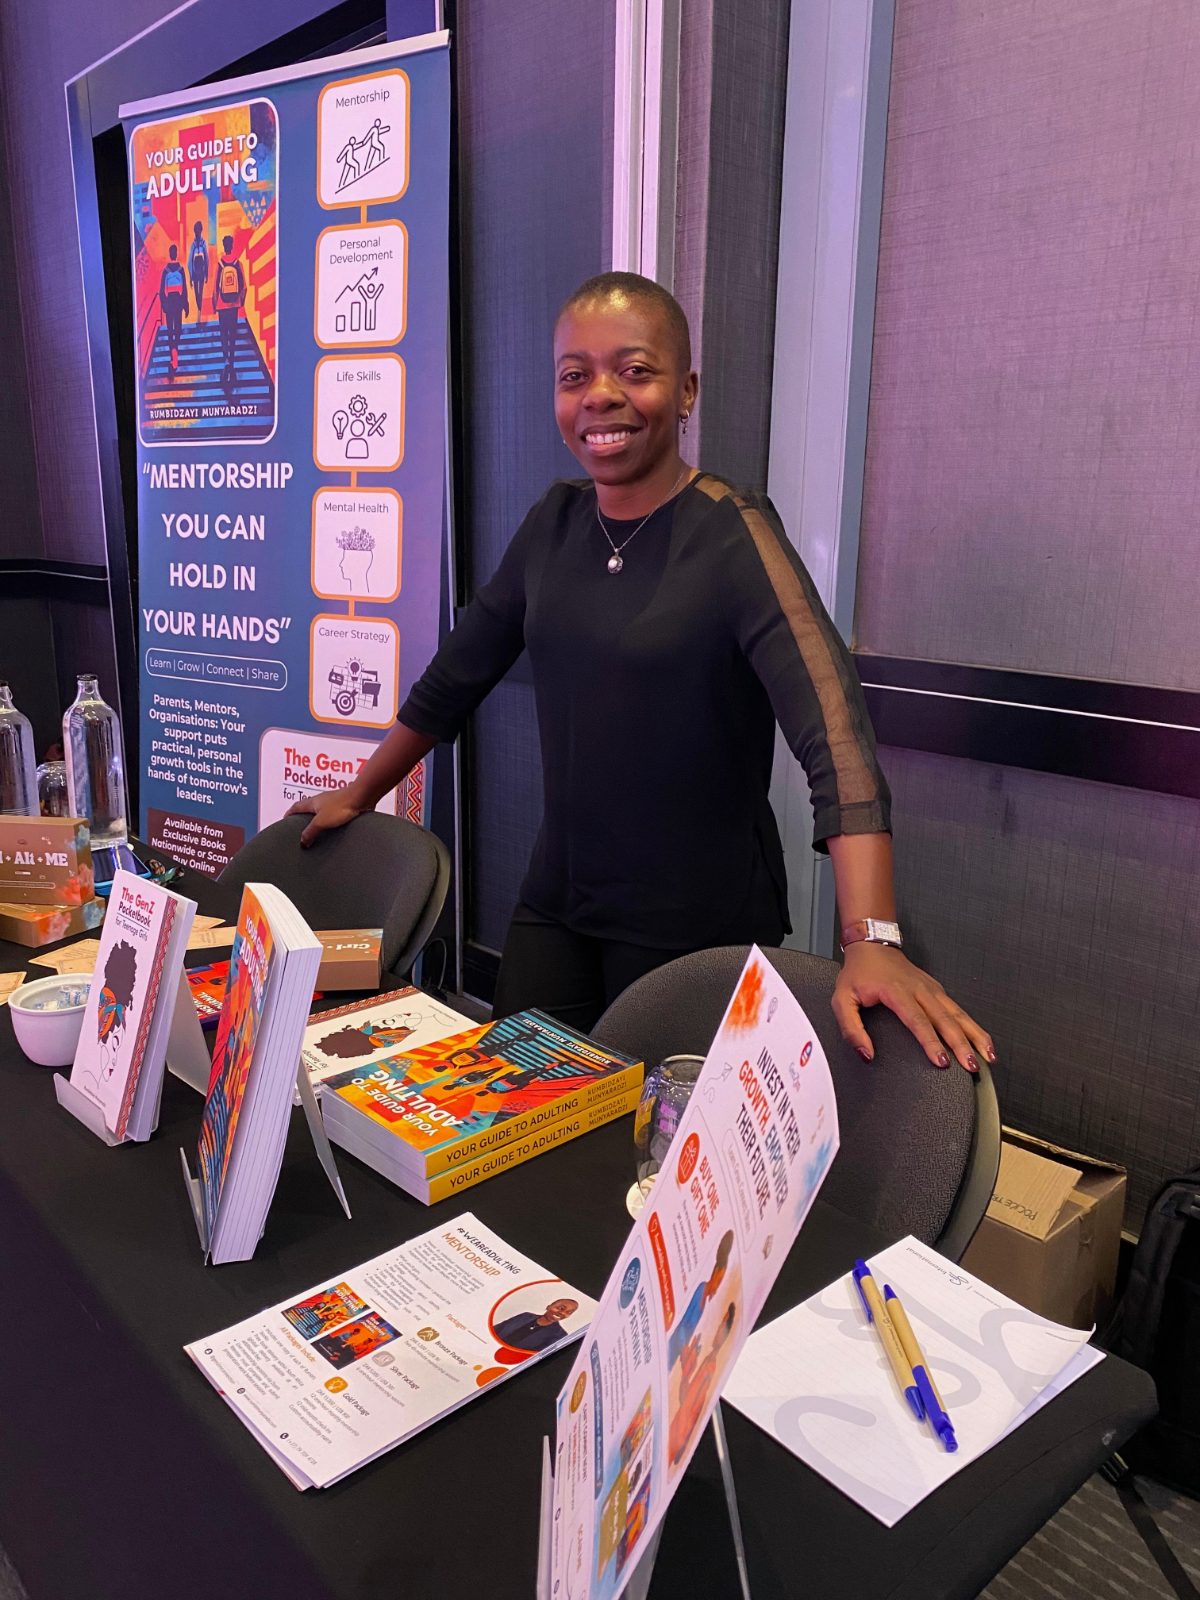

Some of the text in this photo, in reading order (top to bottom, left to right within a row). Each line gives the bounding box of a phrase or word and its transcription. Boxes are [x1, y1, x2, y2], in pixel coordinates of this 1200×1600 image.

[336, 89, 390, 108] Mentorship
[146, 132, 258, 168] YOUR GUIDE TO
[146, 158, 258, 200] ADULTING
[340, 237, 381, 249] Personal
[330, 250, 393, 264] Development
[336, 371, 381, 382] Life Skills
[150, 405, 258, 419] RUMBIDZAYI MUNYARADZI
[323, 502, 389, 514] Mental Health
[161, 513, 265, 540] YOU CAN
[169, 562, 256, 591] HOLD IN
[142, 608, 196, 636] YOUR
[318, 627, 390, 643] Career Strategy
[150, 657, 172, 669] Learn
[177, 660, 200, 672] Grow
[206, 663, 245, 678] Connect
[251, 668, 279, 681] Share
[153, 694, 240, 718] Parents, Mentors,
[149, 709, 245, 733] Organisations: Your
[164, 728, 227, 746] support puts
[152, 740, 242, 764] practical, personal
[284, 748, 311, 767] The
[151, 755, 244, 780] growth tools in the
[148, 767, 248, 796] hands of tomorrow's
[176, 787, 214, 805] leaders.
[283, 789, 295, 801] for
[162, 828, 226, 851] Exclusive Books
[164, 817, 223, 839] Available from
[14, 851, 35, 866] Alt
[44, 852, 69, 867] ME
[151, 837, 195, 857] Nationwide
[197, 849, 206, 860] or
[207, 851, 228, 864] Scan
[189, 858, 216, 874] Online
[121, 887, 134, 904] The
[118, 902, 151, 928] Pocketbook
[245, 914, 258, 939] YOUR
[121, 919, 139, 936] Teenage
[138, 929, 148, 942] Girls
[522, 1018, 612, 1065] RUMBIDZAYI MUNYARADZI
[756, 1046, 784, 1096] INVEST
[351, 1078, 439, 1137] YOUR GUIDE TO
[369, 1070, 465, 1127] ADULTING
[780, 1091, 791, 1117] IN
[446, 1098, 579, 1163] YOUR GUIDE TO ADULTING
[738, 1060, 789, 1214] GROWTH. EMPOWER
[783, 1109, 802, 1165] THEIR
[449, 1121, 580, 1188] YOUR GUIDE TO ADULTING
[735, 1103, 771, 1221] THEIR FUTURE.
[699, 1155, 713, 1187] BUY
[690, 1176, 710, 1241] GIFT ONE
[442, 1232, 501, 1278] MENTORSHIP
[457, 1227, 521, 1275] #WEAREADULTING
[629, 1304, 642, 1373] PATHWAY
[434, 1340, 468, 1367] Bronze Package
[400, 1374, 420, 1391] Package
[341, 1392, 370, 1417] Gold Package
